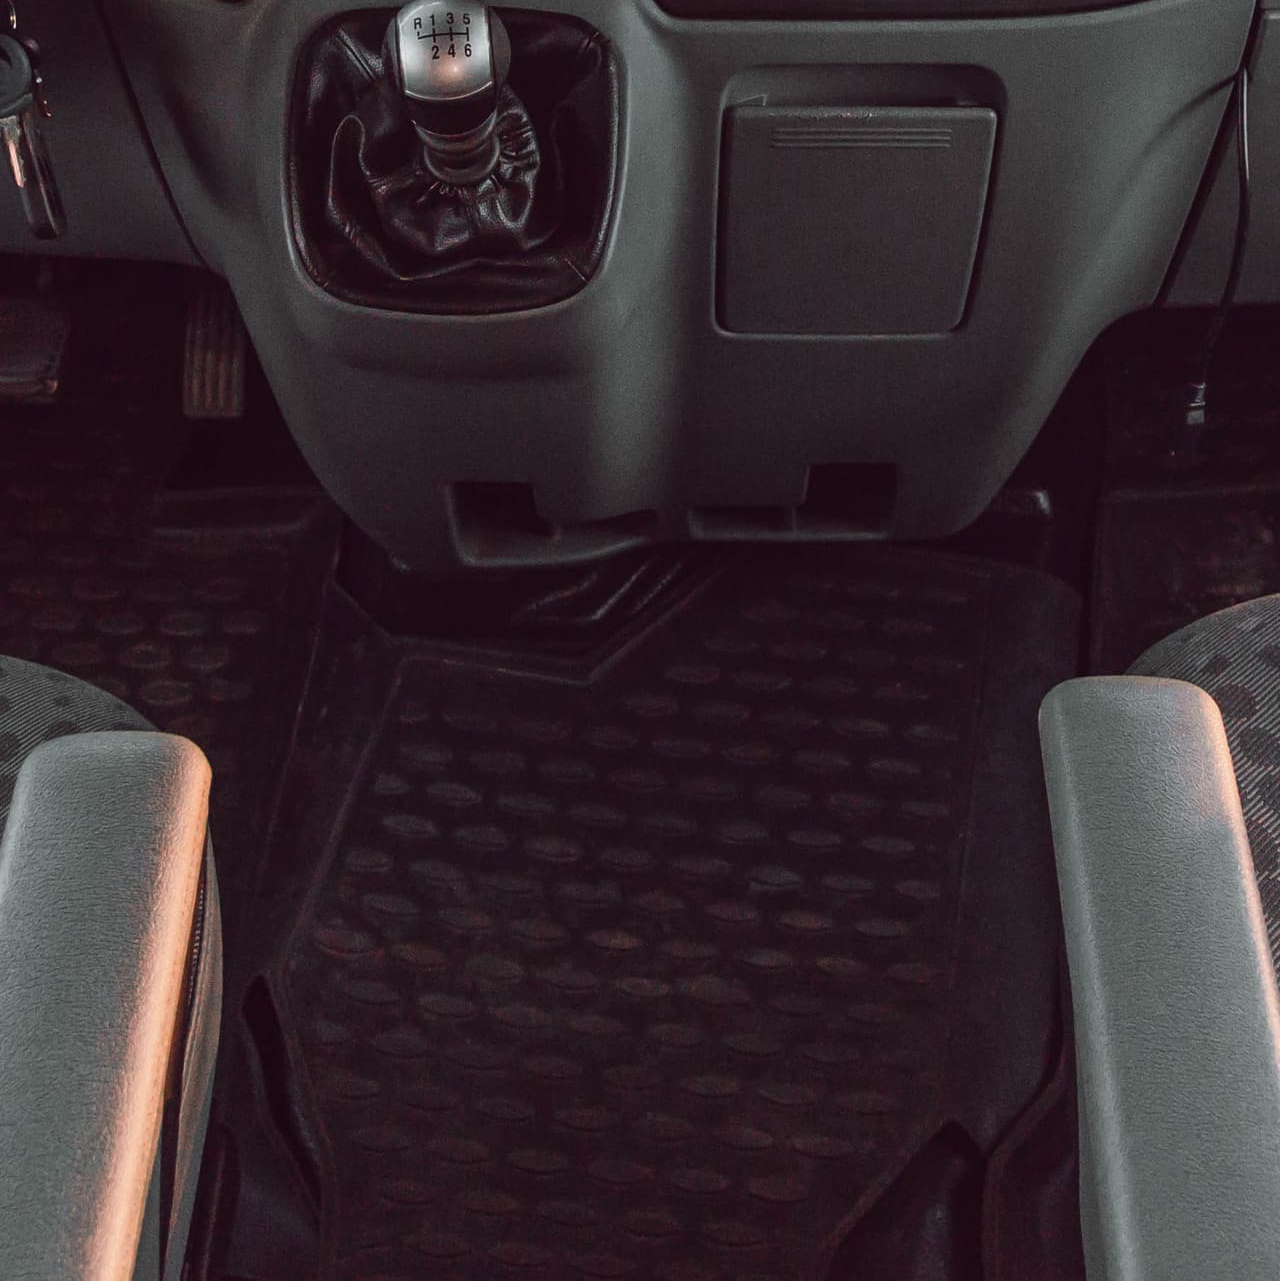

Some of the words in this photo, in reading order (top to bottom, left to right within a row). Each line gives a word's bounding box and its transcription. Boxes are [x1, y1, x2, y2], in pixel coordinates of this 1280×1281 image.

[414, 18, 422, 29] R
[429, 14, 436, 26] 1
[446, 12, 455, 24] 3
[463, 14, 470, 25] 5
[432, 46, 440, 59] 2
[447, 44, 456, 57] 4
[464, 44, 472, 57] 6
